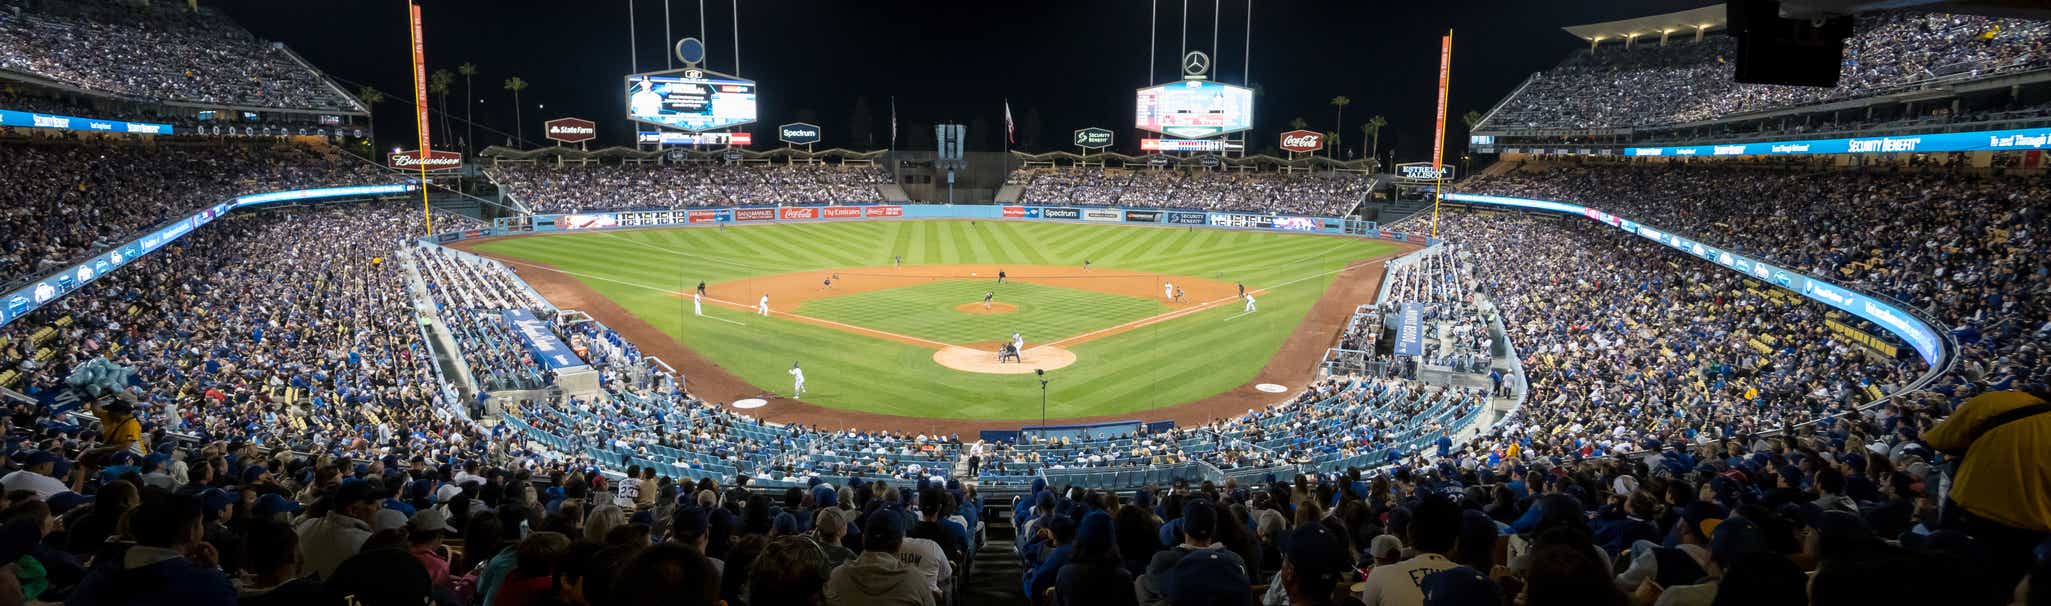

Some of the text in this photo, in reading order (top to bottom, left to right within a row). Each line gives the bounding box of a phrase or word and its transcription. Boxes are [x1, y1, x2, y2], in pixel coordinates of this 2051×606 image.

[783, 129, 815, 137] Spectrum
[392, 155, 460, 166] Budweiser
[1045, 209, 1077, 218] Spectrum
